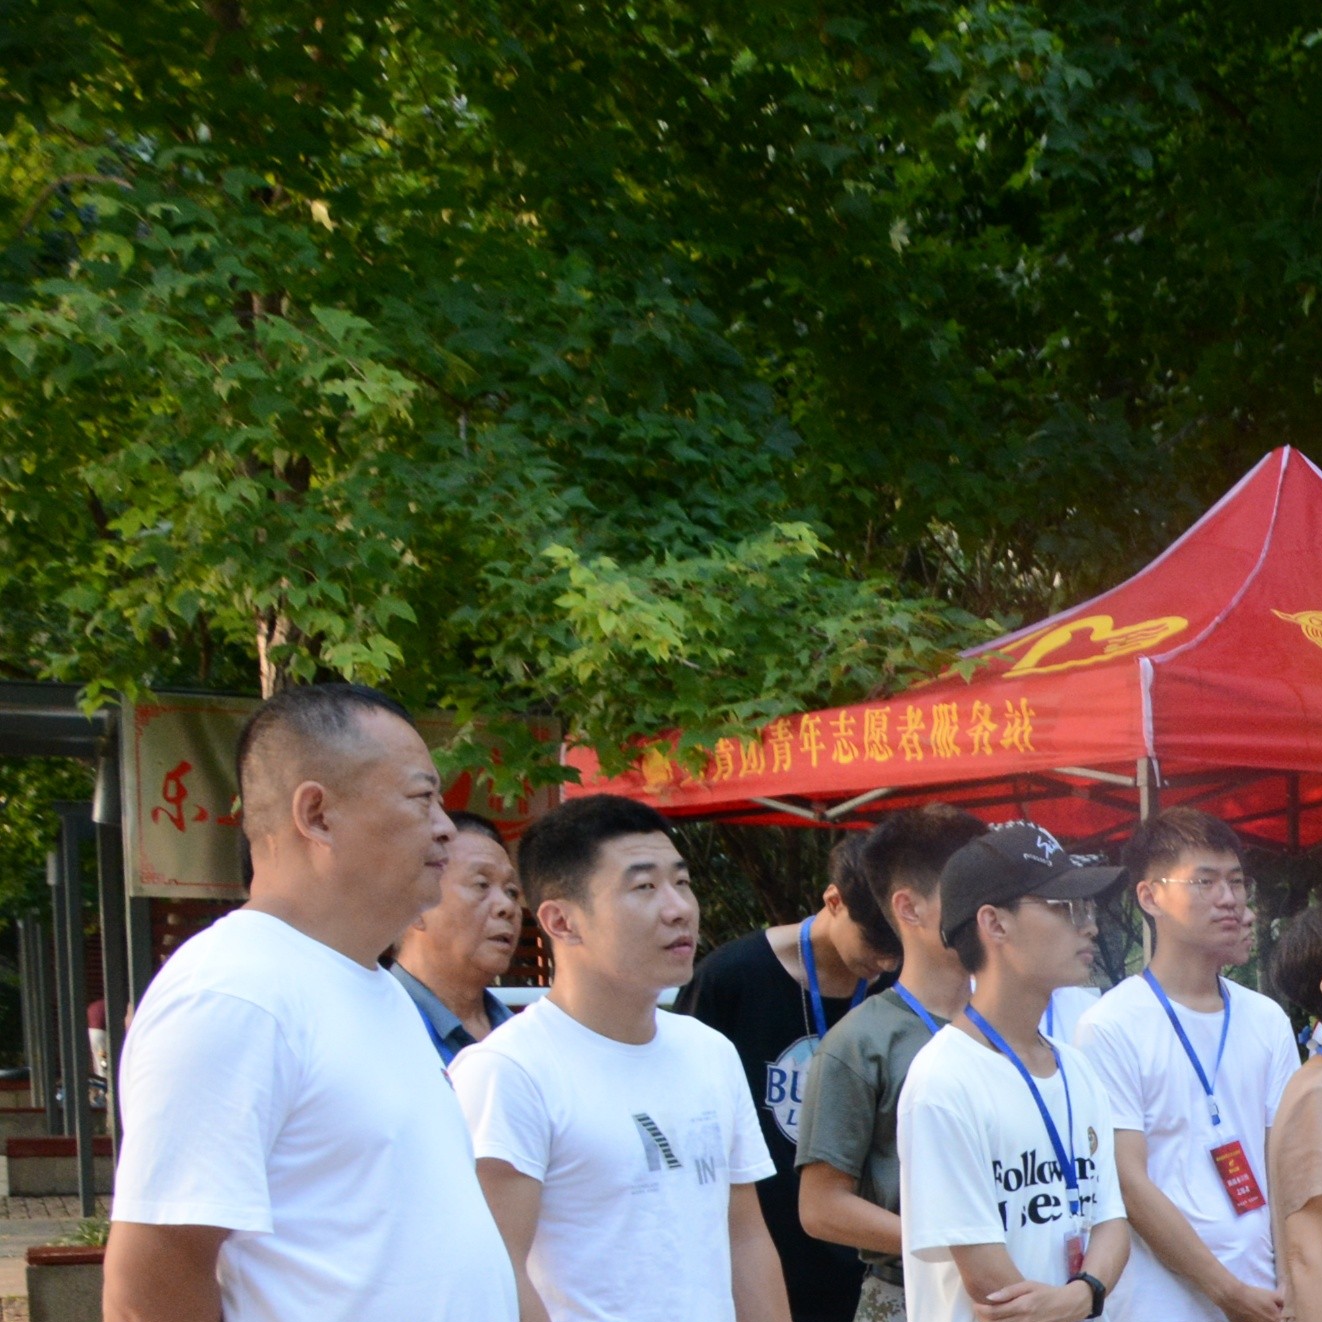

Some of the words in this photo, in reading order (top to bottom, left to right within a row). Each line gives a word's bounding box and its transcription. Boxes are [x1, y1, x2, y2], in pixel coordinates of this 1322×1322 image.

[684, 698, 1037, 783] 青团青年志愿者服务站
